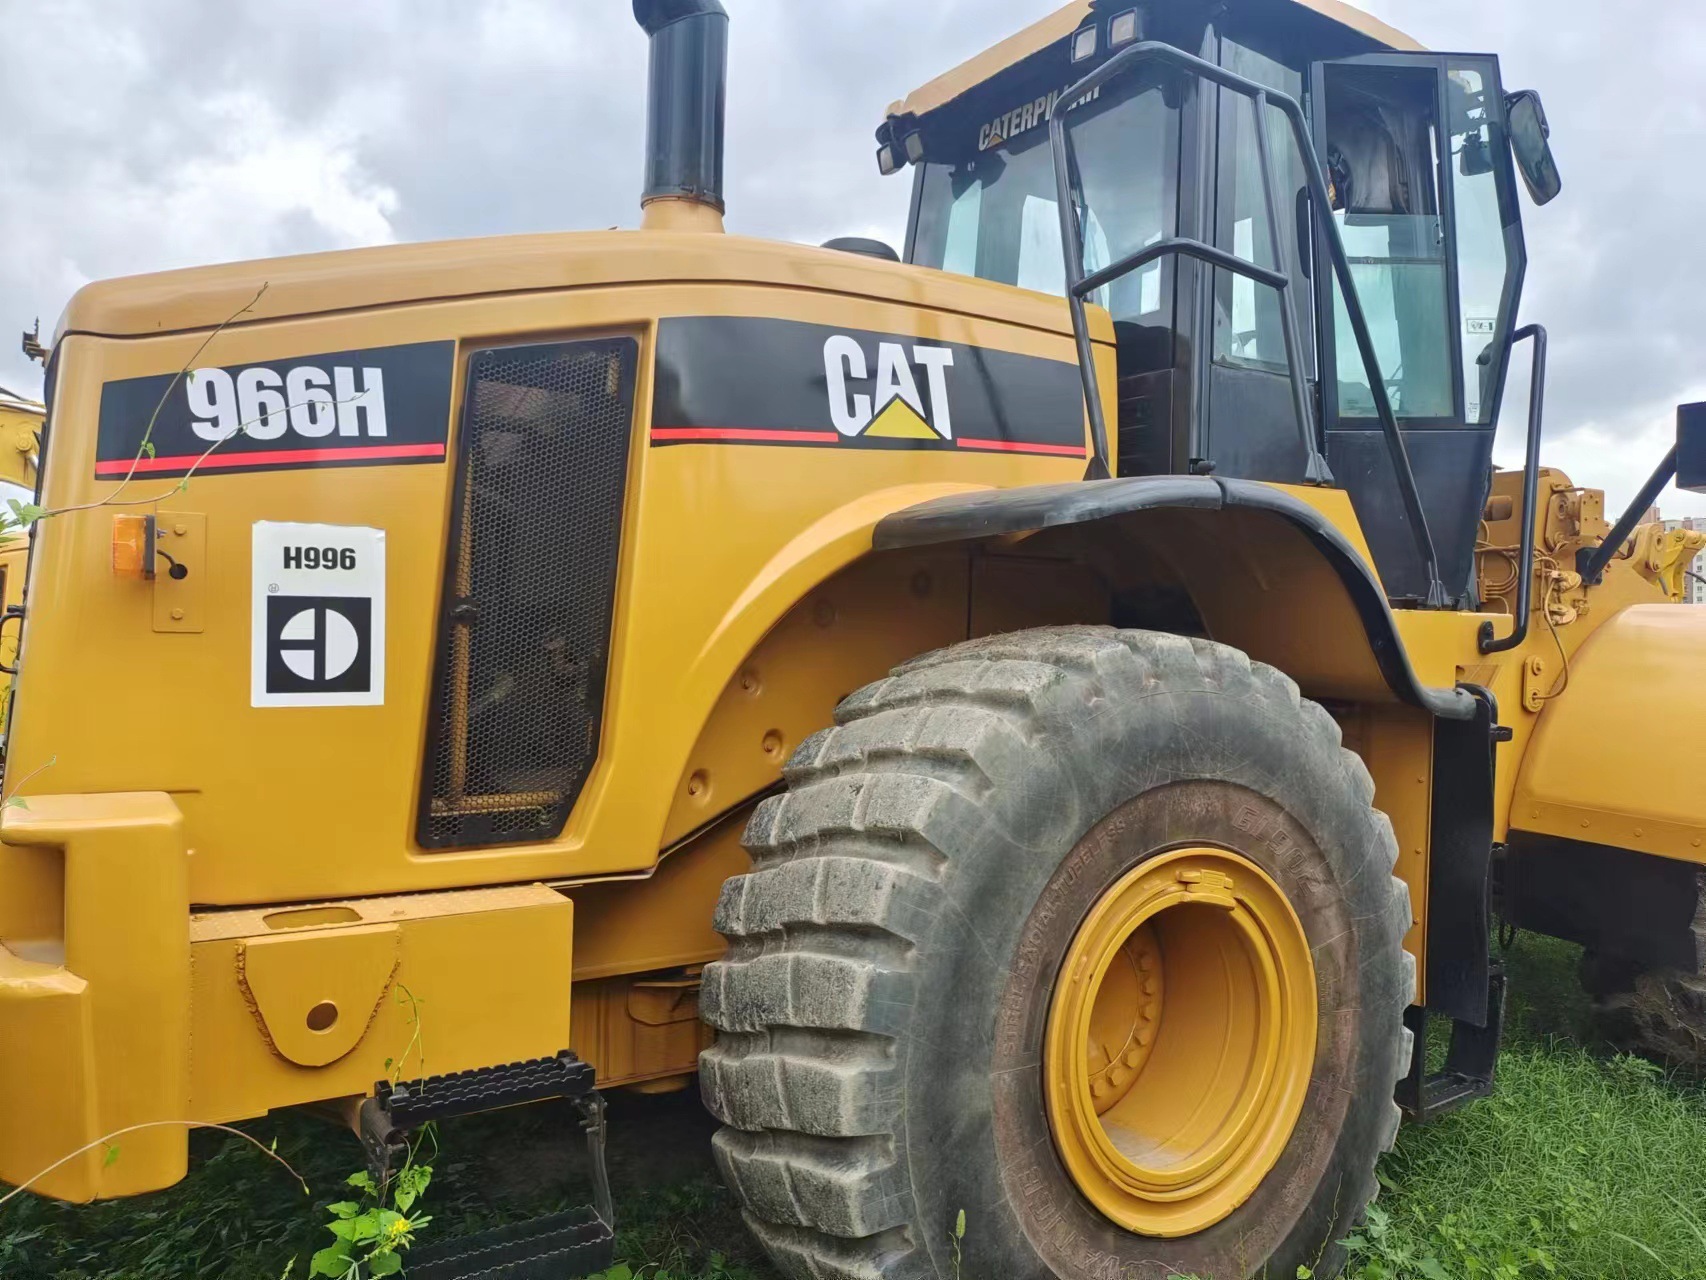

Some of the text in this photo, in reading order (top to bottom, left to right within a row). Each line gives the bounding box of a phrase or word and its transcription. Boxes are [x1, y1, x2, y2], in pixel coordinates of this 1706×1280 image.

[978, 84, 1100, 151] CATERPI
[186, 366, 387, 441] 966H
[823, 334, 954, 440] CAT
